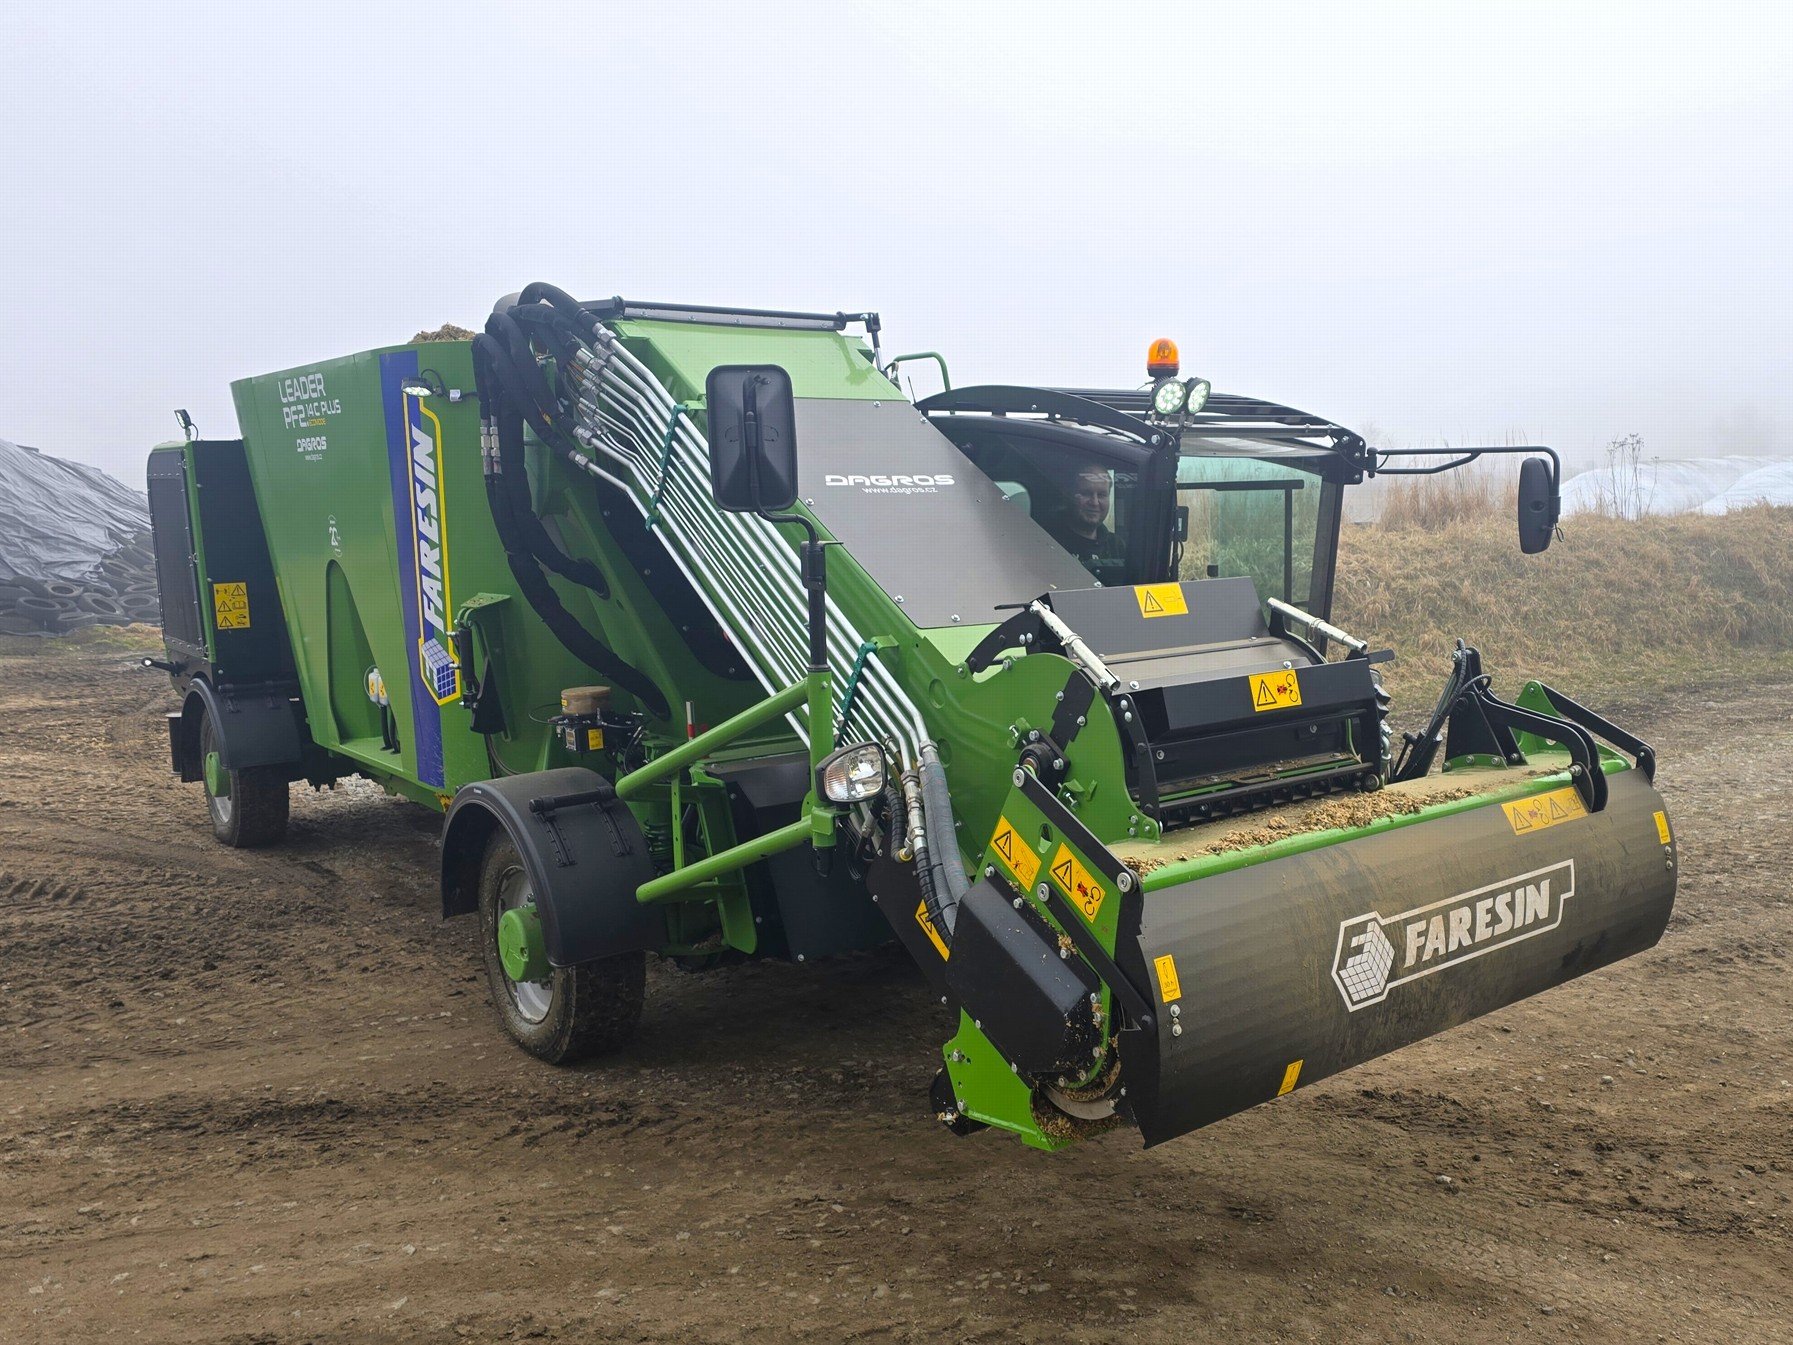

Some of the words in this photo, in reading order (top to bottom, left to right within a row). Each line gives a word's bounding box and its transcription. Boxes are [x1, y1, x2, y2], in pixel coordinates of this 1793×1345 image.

[278, 373, 326, 403] LEADER
[320, 399, 341, 415] PLUS
[296, 436, 327, 452] DAGROS
[825, 474, 955, 486] DAGROS
[861, 486, 938, 495] www.dagros.cz
[411, 423, 445, 633] FARESIN
[1403, 878, 1551, 969] FARESIN
